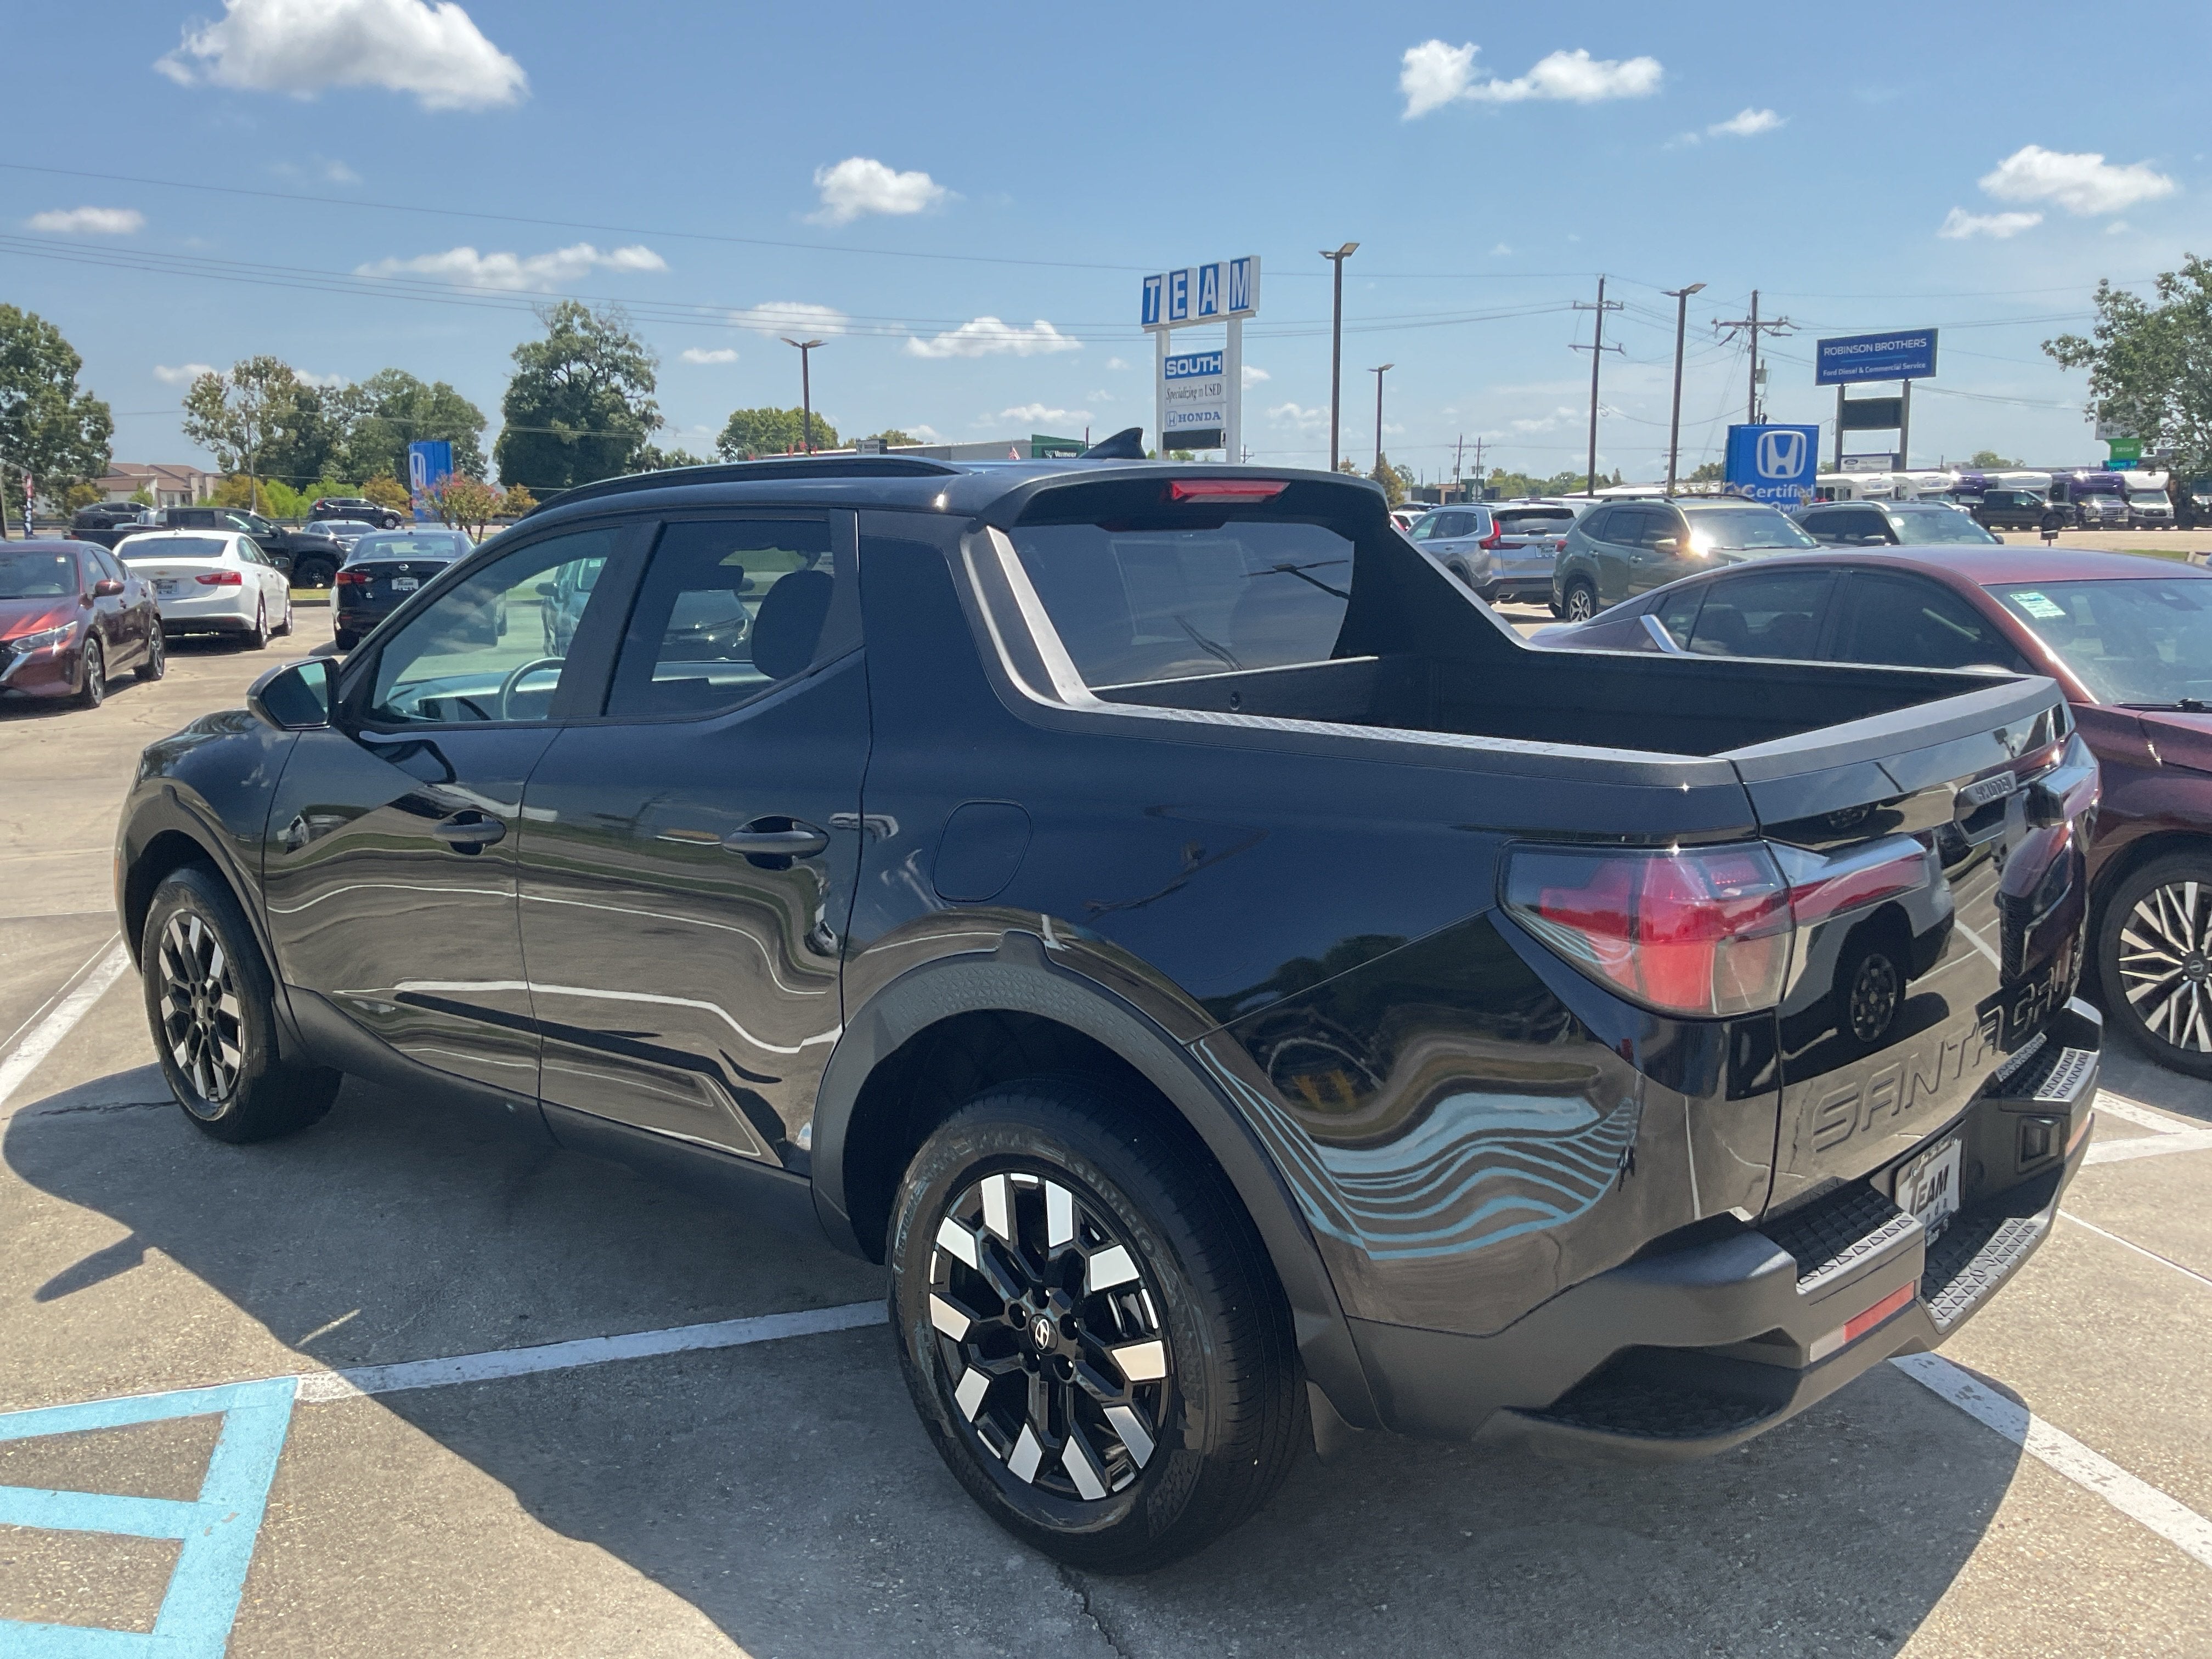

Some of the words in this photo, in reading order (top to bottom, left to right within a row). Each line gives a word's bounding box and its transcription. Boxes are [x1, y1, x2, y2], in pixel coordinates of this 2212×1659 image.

[1146, 261, 1250, 321] TEAM
[1824, 344, 1873, 356] ROBINSON
[1875, 338, 1927, 351] BROTHERS
[1166, 356, 1221, 376] SOUTH
[1865, 363, 1901, 373] Commercial
[1166, 386, 1197, 403] Specializing
[1198, 385, 1203, 397] in
[1205, 383, 1221, 396] USED
[1178, 411, 1221, 422] HONDA
[1741, 484, 1814, 498] Certified
[1811, 1005, 2004, 1153] SANTA
[1908, 1164, 1950, 1216] TEAM
